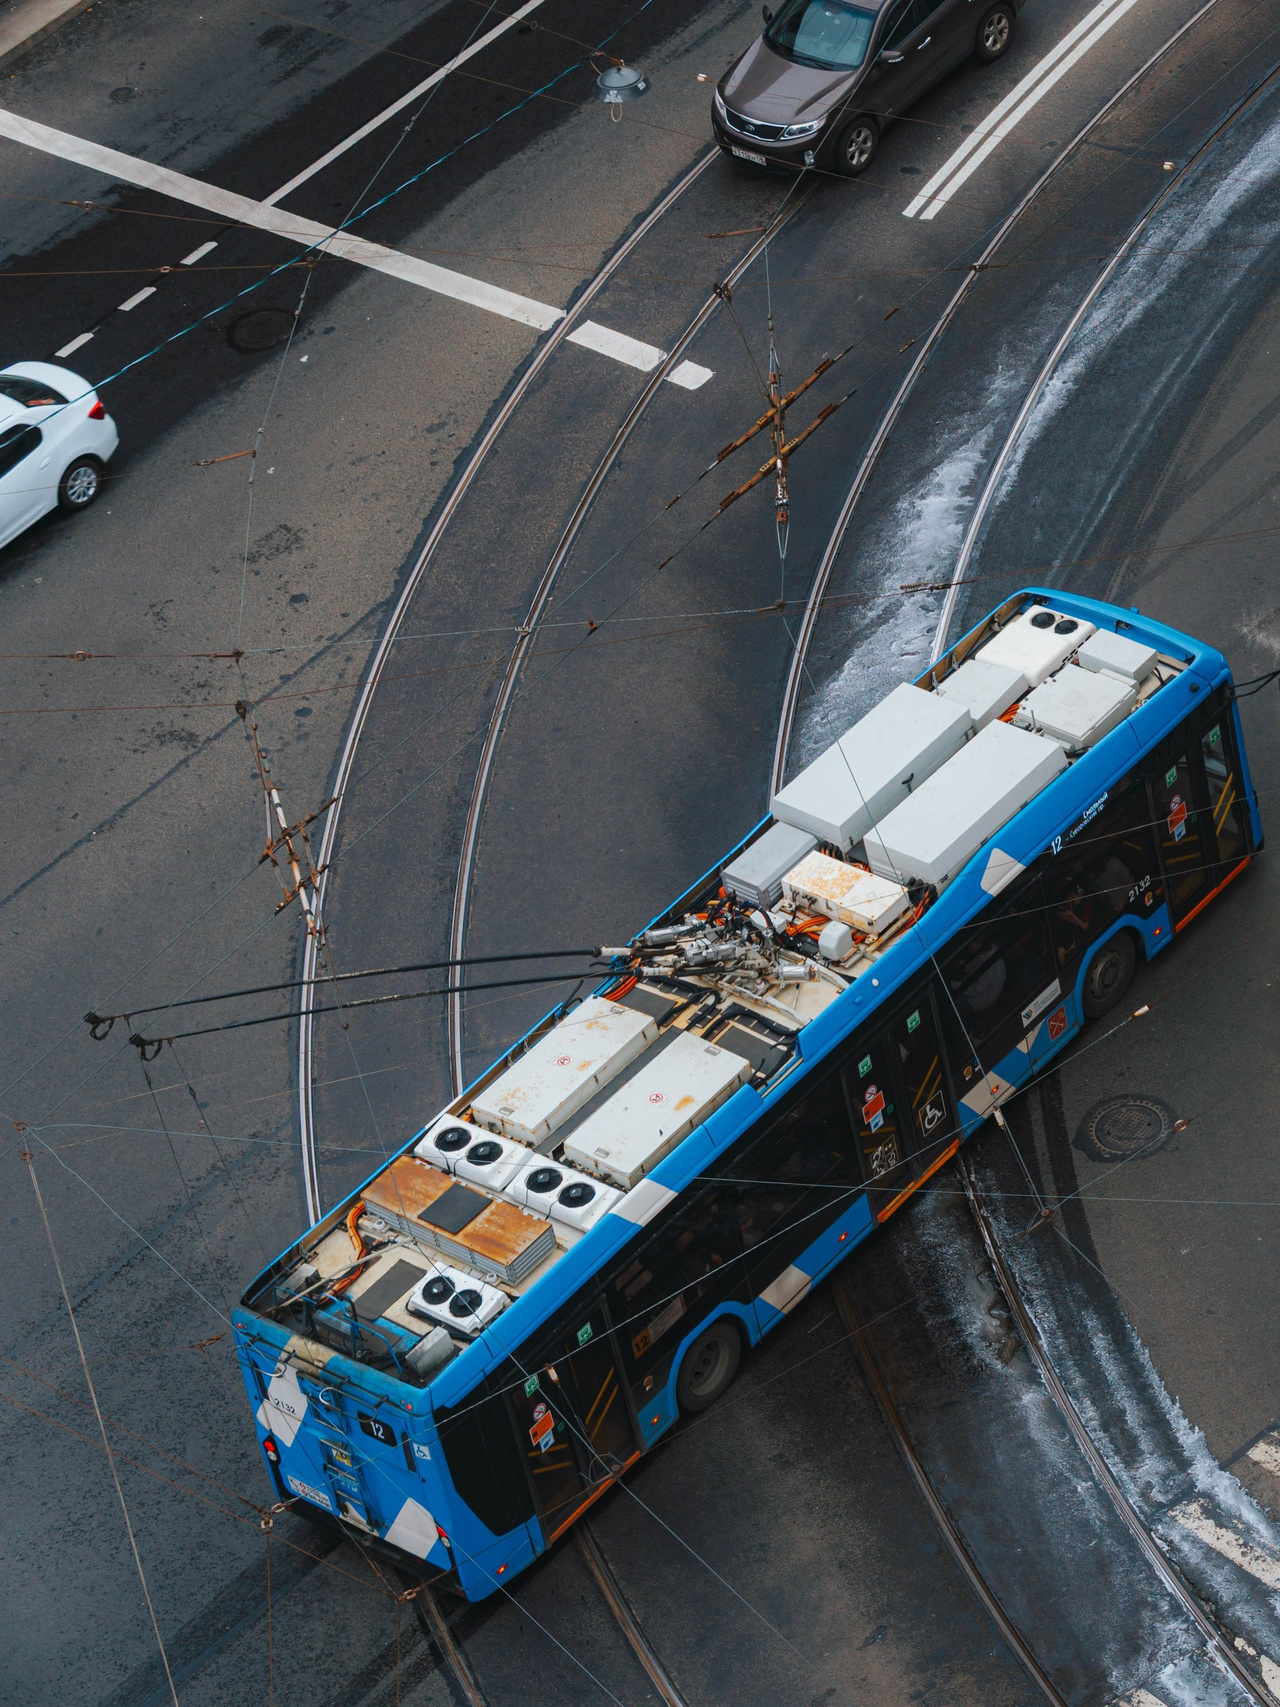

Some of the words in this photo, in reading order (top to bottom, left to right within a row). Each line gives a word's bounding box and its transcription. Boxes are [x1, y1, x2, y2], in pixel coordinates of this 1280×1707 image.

[1051, 835, 1063, 855] 12
[1128, 875, 1151, 902] 2132
[634, 1334, 649, 1352] 12
[274, 1398, 297, 1415] 2132
[370, 1421, 385, 1439] 12
